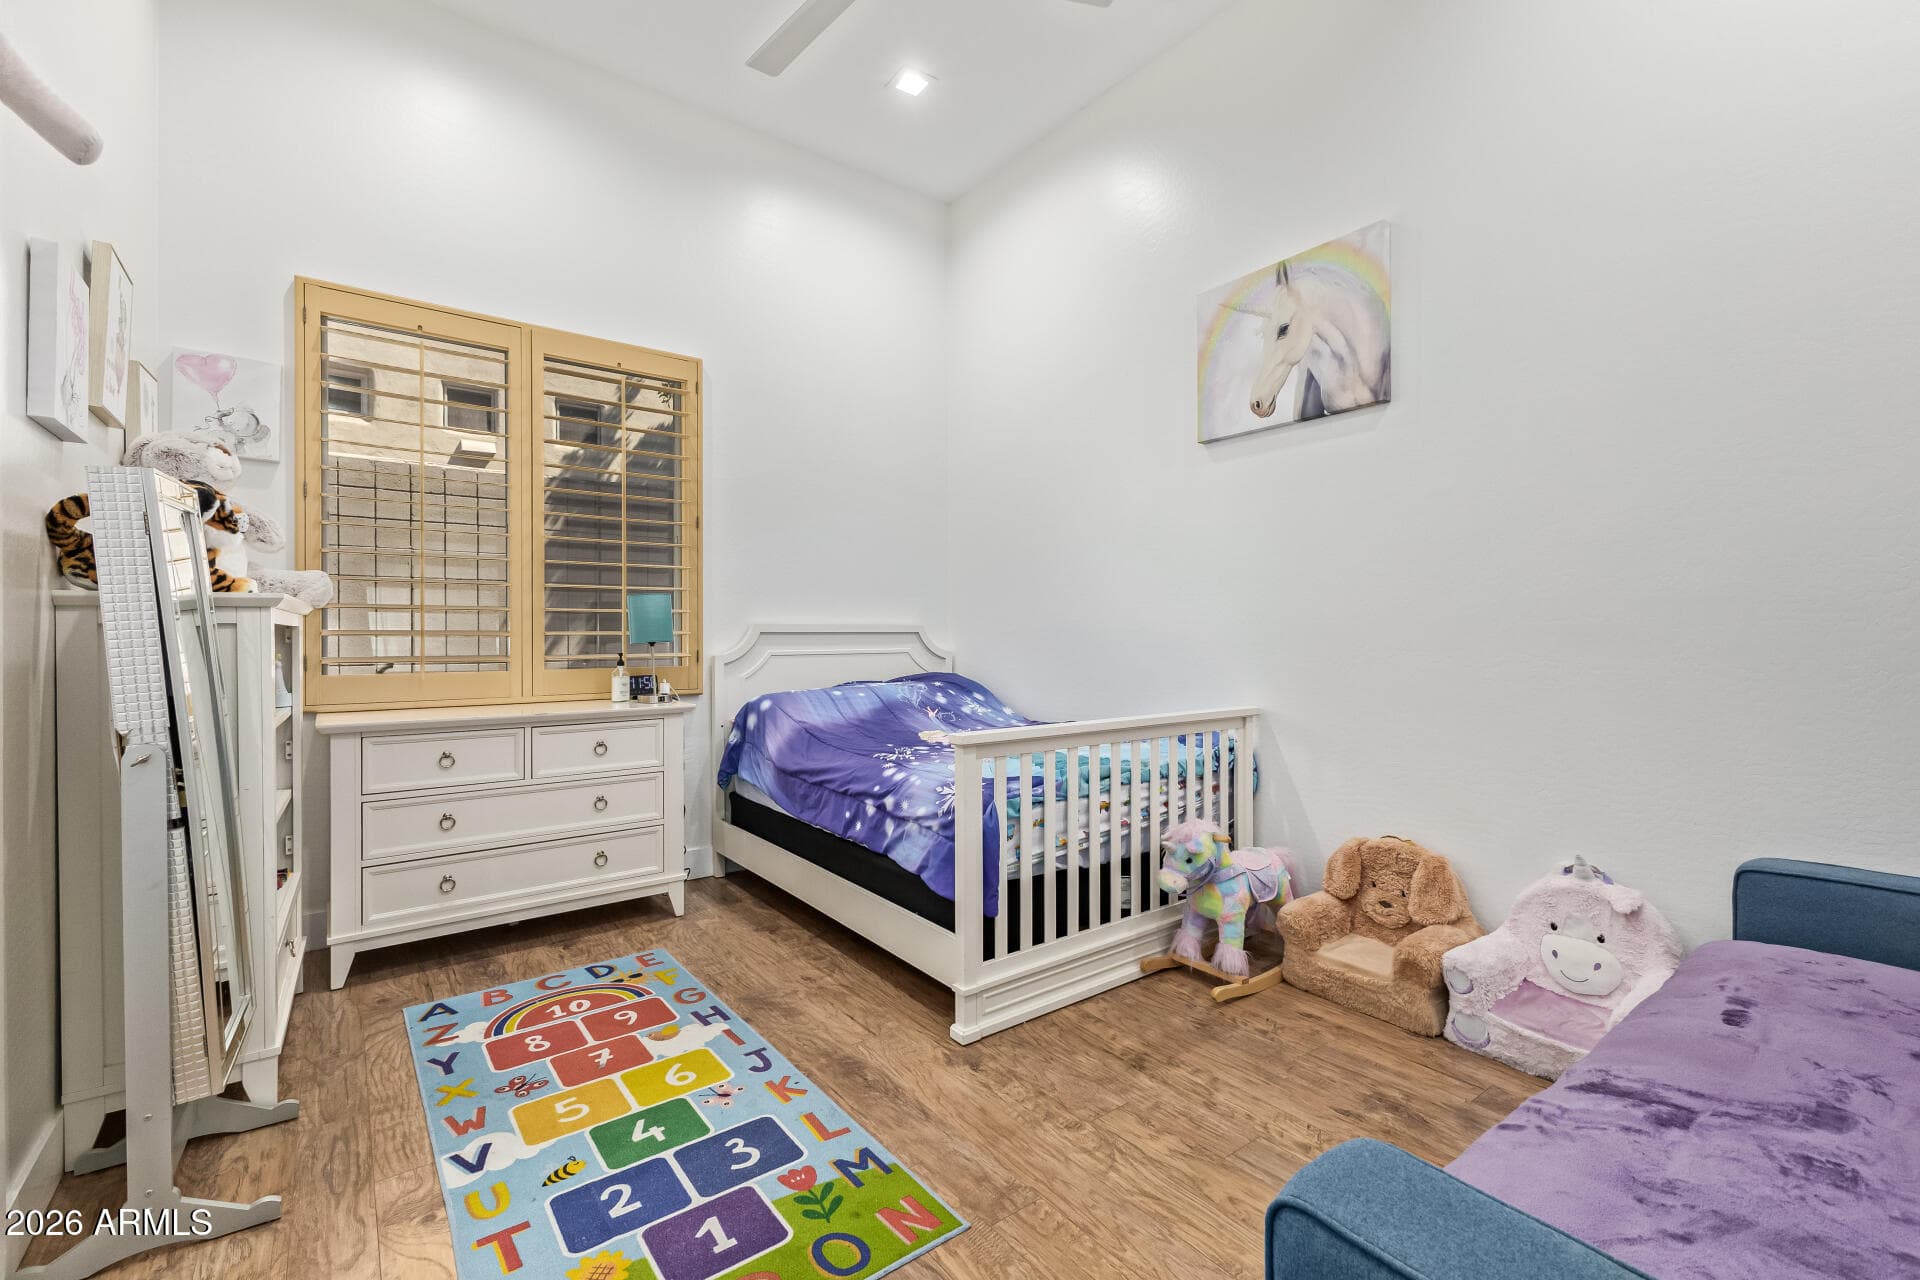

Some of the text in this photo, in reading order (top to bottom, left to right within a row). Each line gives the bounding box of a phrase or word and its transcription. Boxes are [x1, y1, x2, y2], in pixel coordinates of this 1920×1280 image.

[585, 964, 617, 979] D
[634, 952, 665, 968] E
[534, 974, 572, 991] C
[652, 967, 681, 986] F
[481, 989, 513, 1007] B
[673, 987, 707, 1004] G
[418, 1002, 459, 1022] A
[546, 999, 591, 1018] 10
[613, 1010, 638, 1025] 9
[690, 1005, 731, 1026] H
[422, 1022, 460, 1047] Z
[524, 1035, 551, 1052] 8
[721, 1028, 746, 1046] I
[427, 1051, 460, 1076] Y
[588, 1048, 614, 1069] 7
[741, 1047, 773, 1073] J
[665, 1063, 697, 1086] 6
[435, 1077, 480, 1107] X
[764, 1075, 808, 1105] K
[441, 1105, 487, 1137] W
[555, 1097, 590, 1123] 5
[631, 1118, 666, 1143] 4
[800, 1112, 851, 1142] L
[447, 1142, 492, 1175] V
[724, 1137, 761, 1171] 3
[829, 1146, 893, 1188] M
[464, 1181, 511, 1220] U
[600, 1182, 643, 1219] 2
[875, 1195, 943, 1245] N
[695, 1215, 738, 1254] 1
[471, 1220, 531, 1276] T
[808, 1232, 871, 1279] O
